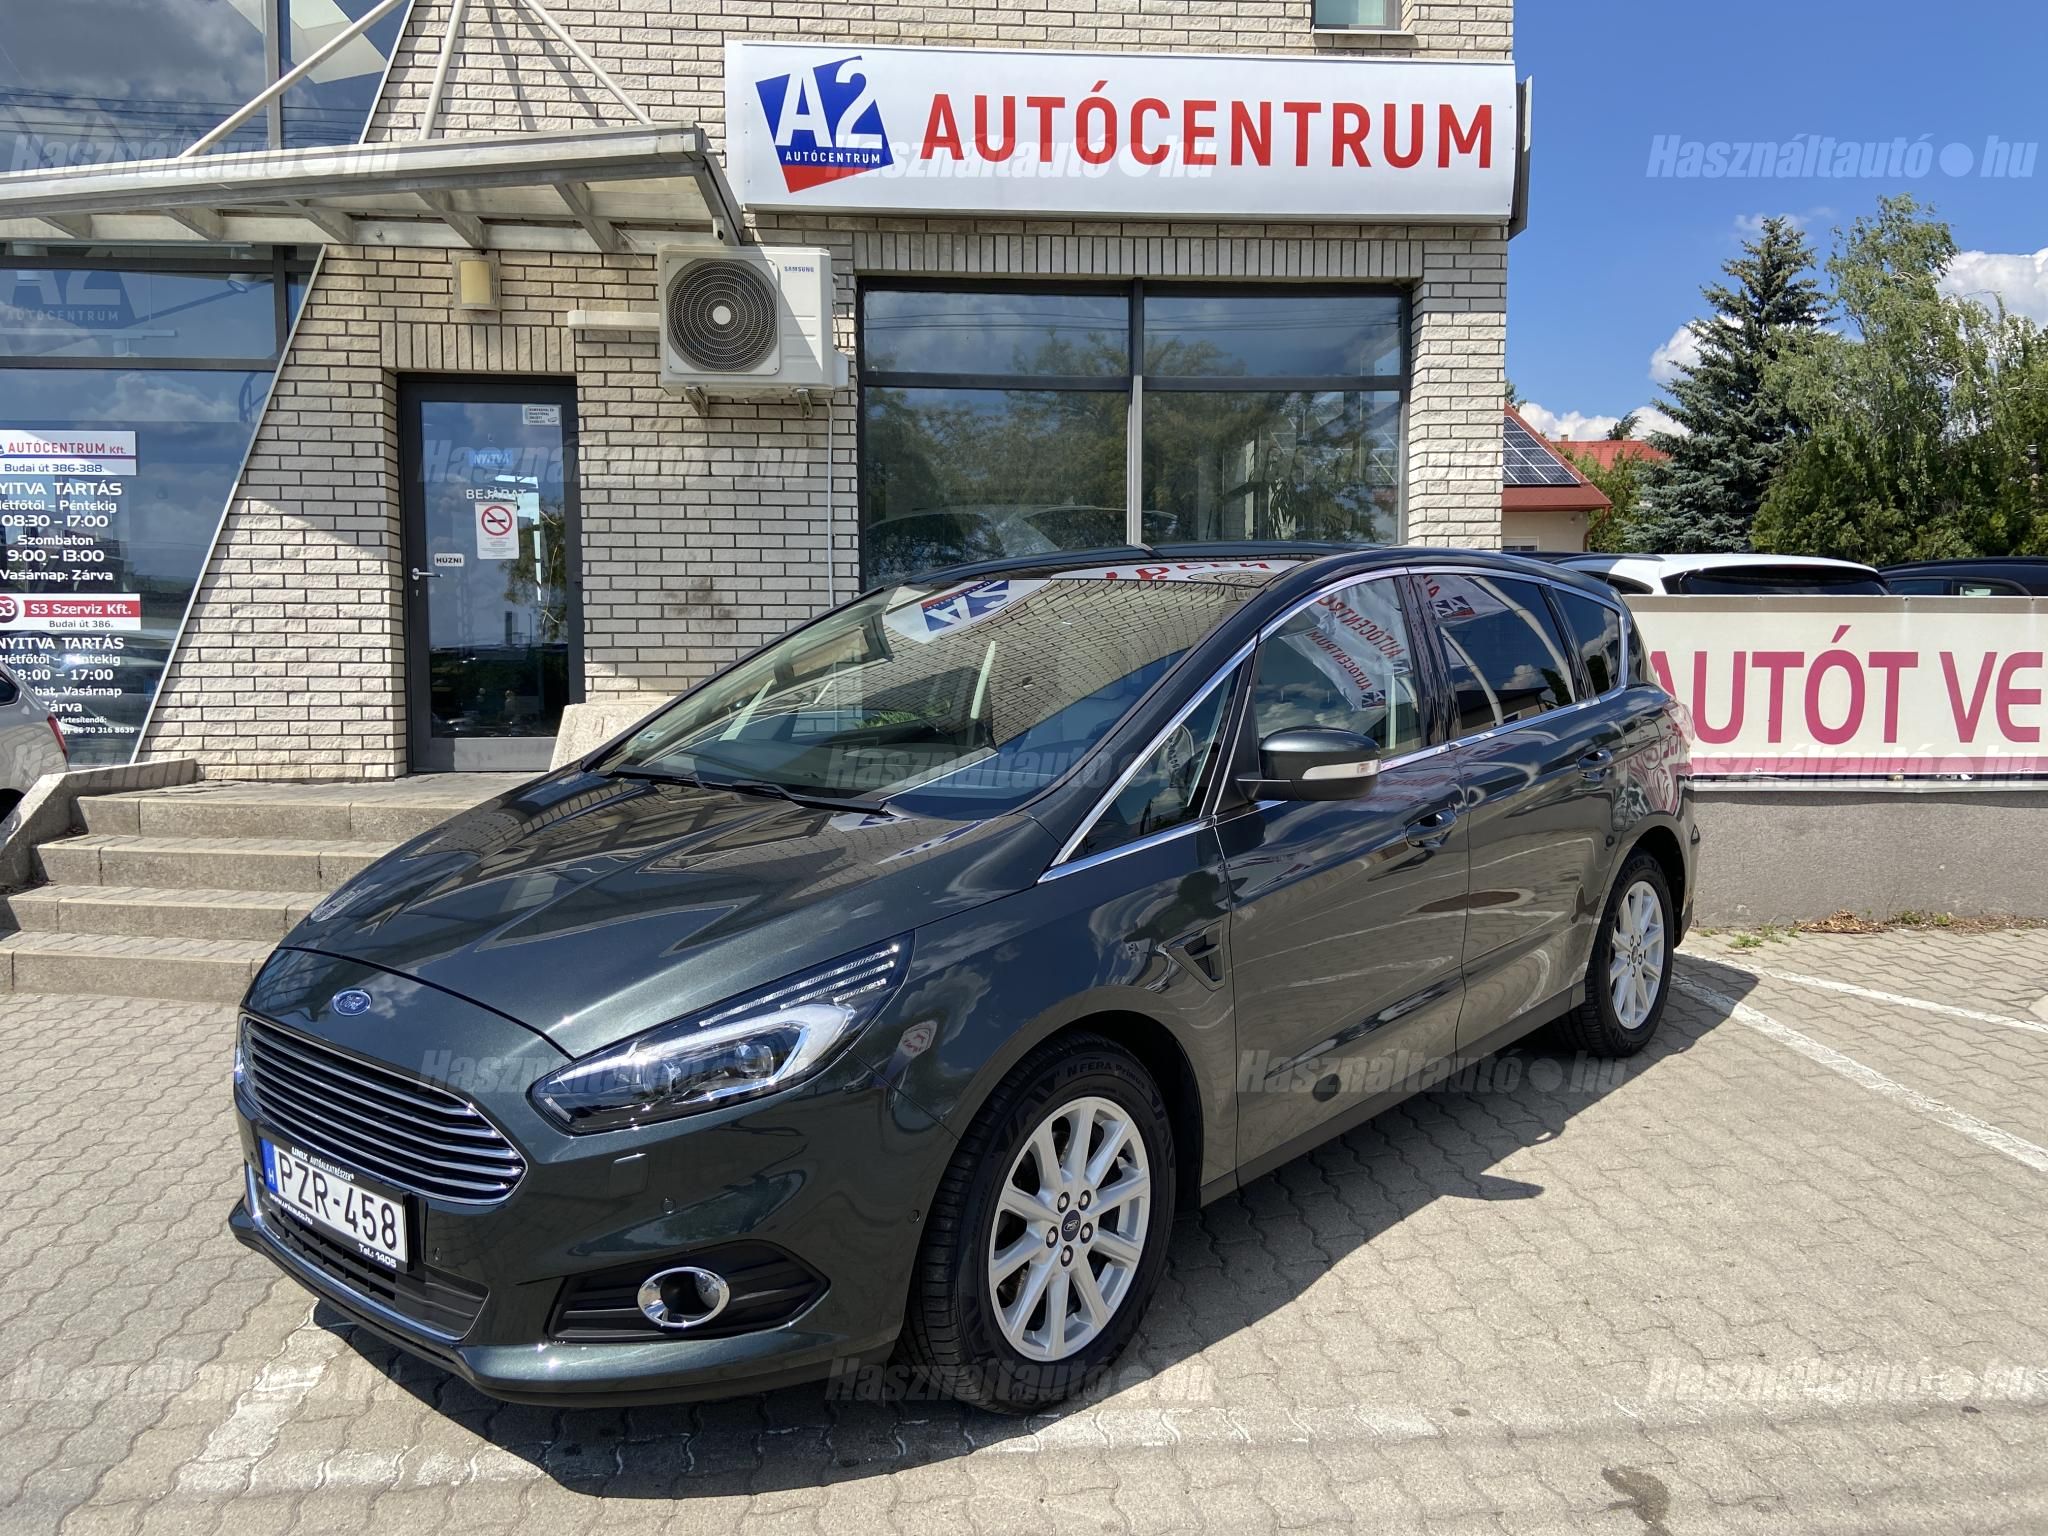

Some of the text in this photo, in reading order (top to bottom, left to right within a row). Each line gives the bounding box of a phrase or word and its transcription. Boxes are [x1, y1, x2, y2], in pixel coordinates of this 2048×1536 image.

[774, 56, 882, 148] A2
[920, 80, 1492, 169] AUTÓCENTRUM
[785, 149, 880, 165] AUTÓCENTRUM
[784, 265, 815, 273] SAMSUNG
[109, 445, 126, 454] Kft.
[4, 463, 35, 472] Budai
[38, 463, 49, 472] út
[53, 480, 122, 495] TARTÁS
[0, 500, 45, 511] étfőtől
[60, 500, 117, 513] Péntekig
[1, 515, 50, 527] 08:30
[66, 515, 109, 527] 17:00
[17, 535, 94, 546] Szombaton
[7, 549, 46, 562] 9:00
[63, 549, 105, 562] 13:00
[0, 569, 113, 582] Vasárnap: Zárva
[30, 603, 132, 614] S3 Szerviz Kft.
[49, 620, 114, 628] Budai út 386.
[62, 634, 124, 650] TARTÁS
[0, 654, 50, 665] Hétfőtől
[70, 669, 114, 681] 17:00
[62, 686, 122, 698] Vasárnap
[268, 1168, 275, 1185] H
[278, 1152, 397, 1251] PZR-458
[375, 1251, 397, 1268] 1405
